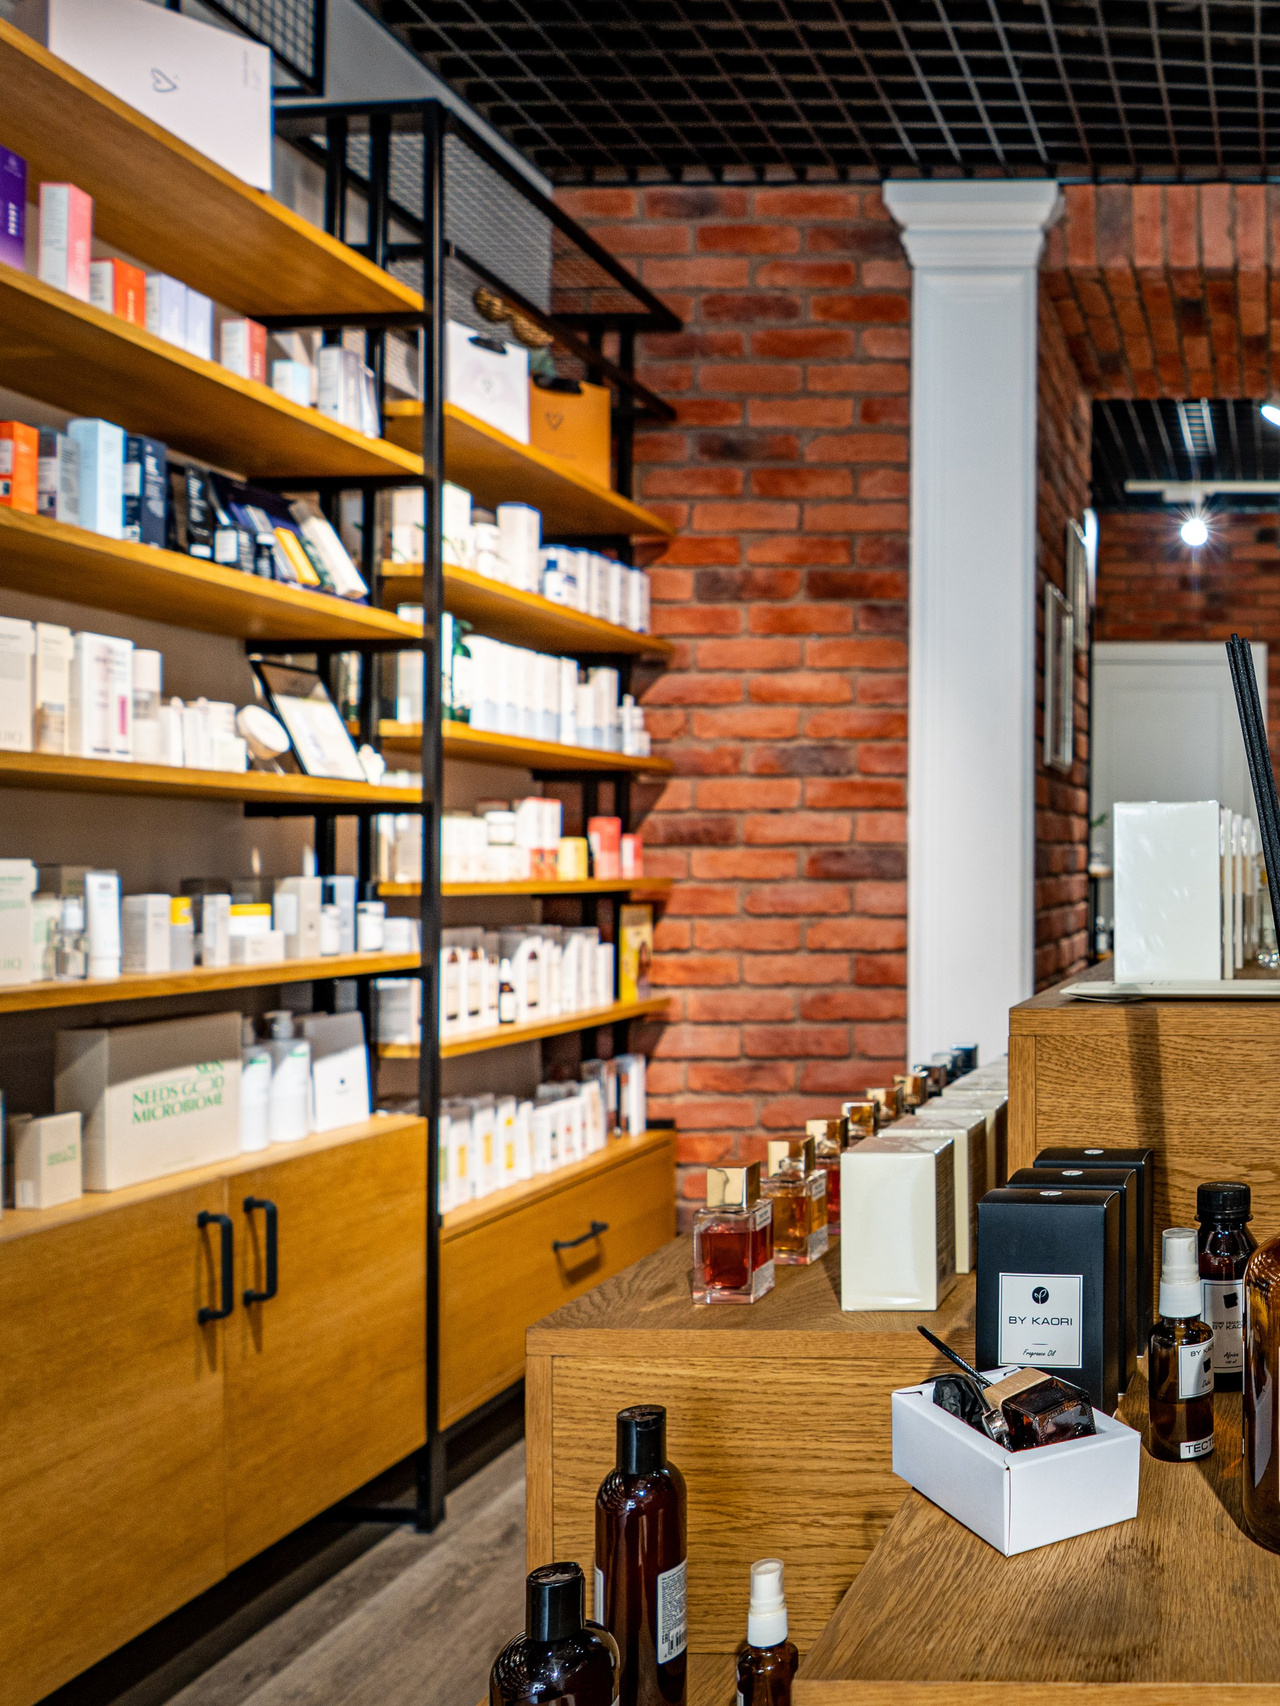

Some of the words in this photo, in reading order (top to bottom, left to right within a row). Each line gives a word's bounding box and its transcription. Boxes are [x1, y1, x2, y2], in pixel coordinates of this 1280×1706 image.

[1008, 1316, 1026, 1325] BY
[1032, 1317, 1072, 1326] KAORI
[1023, 1349, 1045, 1358] Fragrance
